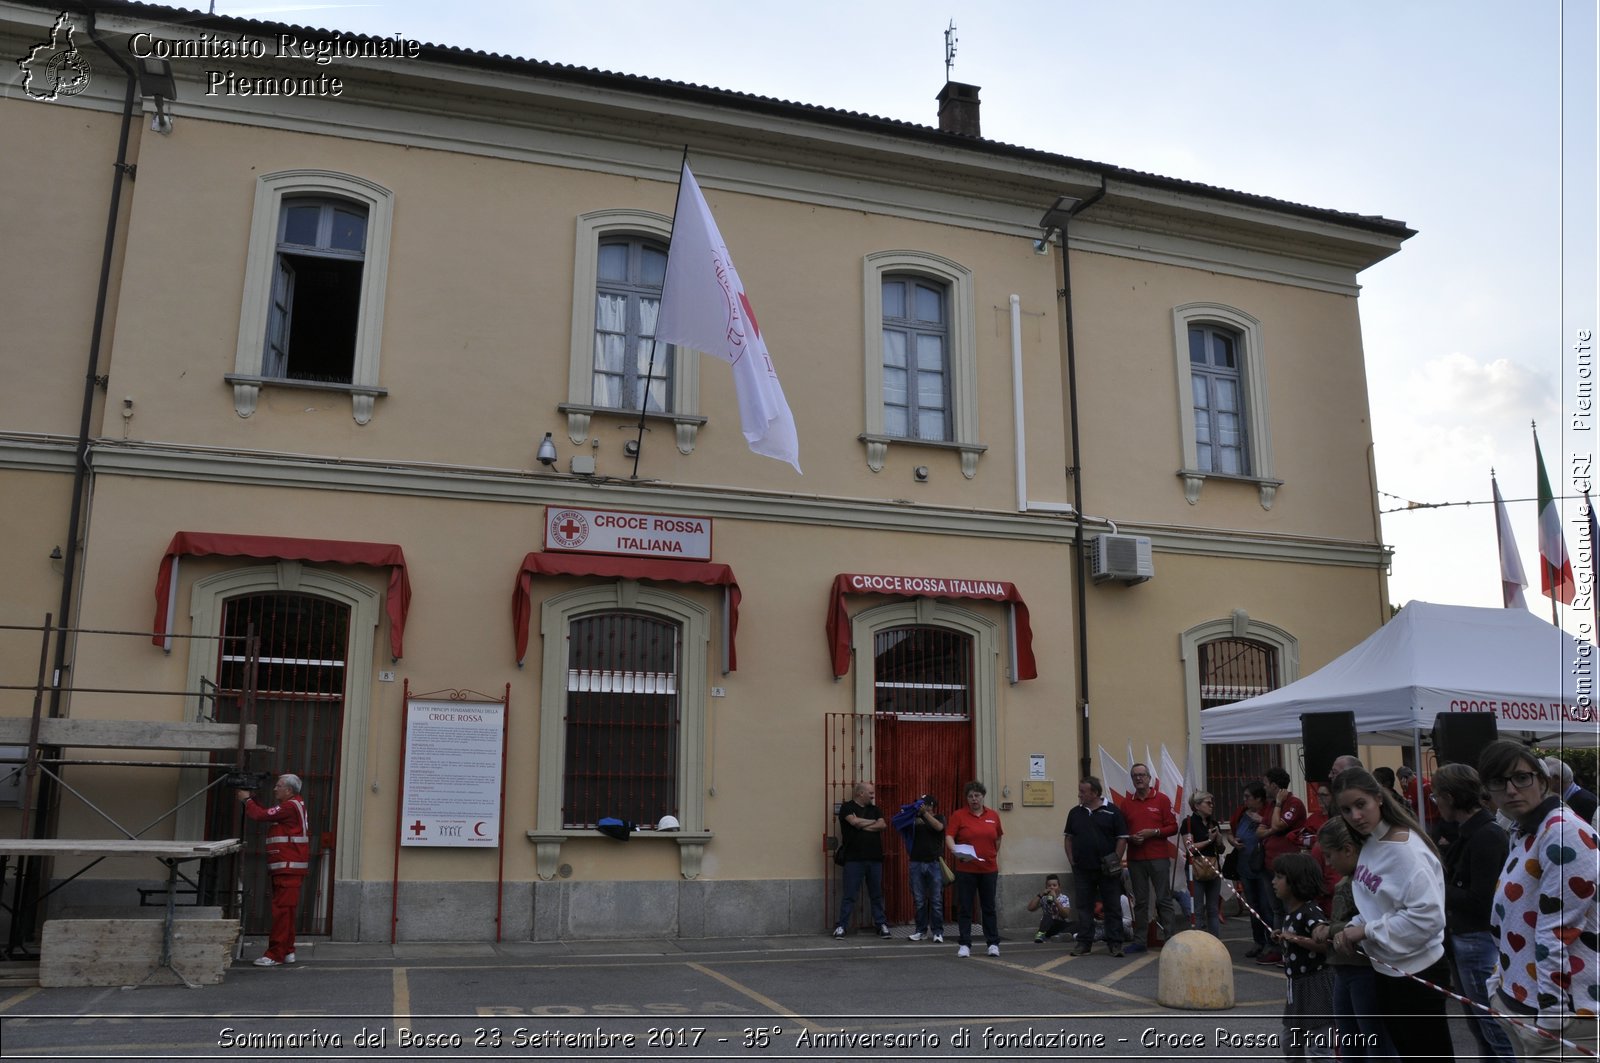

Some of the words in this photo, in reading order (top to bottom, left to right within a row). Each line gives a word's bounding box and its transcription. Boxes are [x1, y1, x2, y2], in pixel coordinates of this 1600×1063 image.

[594, 515, 648, 530] CROCE
[653, 519, 704, 534] ROSSA
[617, 537, 683, 552] ITALIANA
[852, 575, 901, 590] CROCE
[904, 578, 948, 593] ROSSA
[950, 580, 1005, 596] ITALIANA
[429, 713, 456, 722] CROCE
[458, 714, 483, 722] ROSSA
[1450, 700, 1498, 720] CROCE
[1501, 701, 1548, 721] ROSSA
